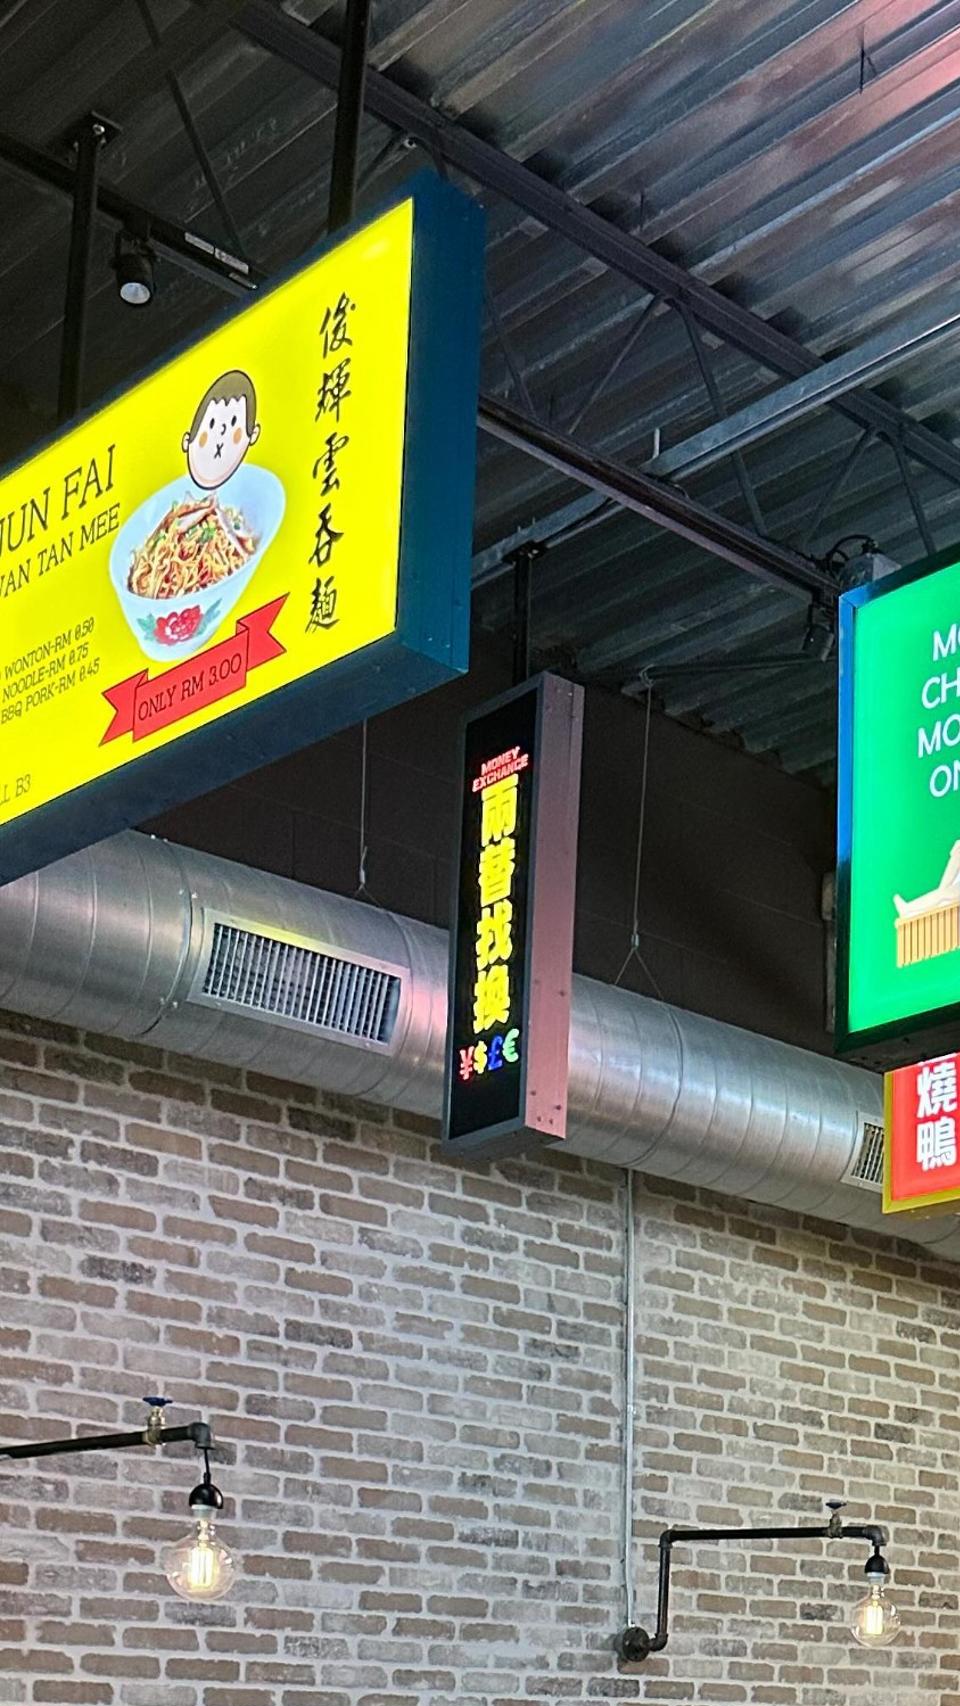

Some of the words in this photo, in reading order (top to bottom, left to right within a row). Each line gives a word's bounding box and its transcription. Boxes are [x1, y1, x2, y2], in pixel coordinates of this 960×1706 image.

[61, 444, 115, 520] FAI
[37, 531, 73, 577] TAN
[79, 503, 120, 551] MEE
[138, 685, 177, 721] ONLY
[181, 671, 204, 702] RM
[208, 653, 242, 686] 3.00
[472, 754, 529, 792] EXCHANGE
[481, 746, 520, 776] MONEY
[916, 1053, 958, 1171] 燒鴨
